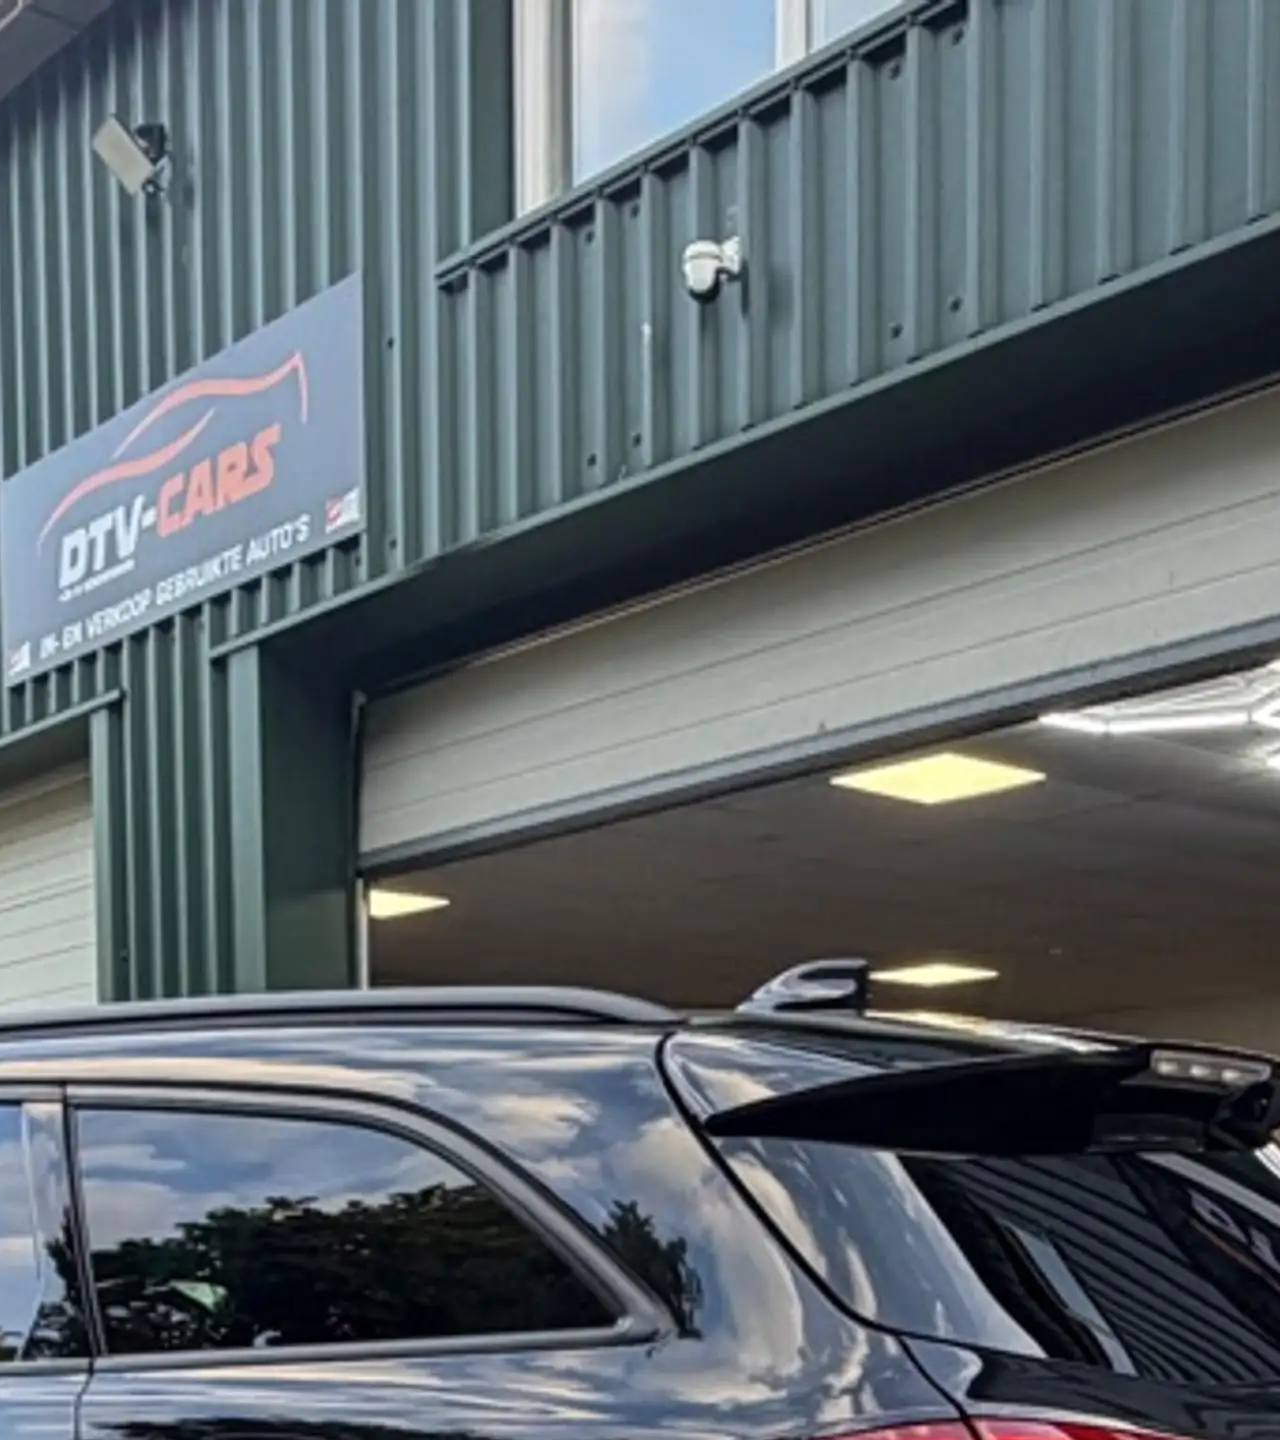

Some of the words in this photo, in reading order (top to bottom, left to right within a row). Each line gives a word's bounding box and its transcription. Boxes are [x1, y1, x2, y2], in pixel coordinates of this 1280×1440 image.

[58, 422, 282, 589] DTV-CARS
[85, 587, 153, 640] VERKOOP
[156, 543, 243, 605] GEBRUIKTE
[246, 512, 312, 566] AUTO'S
